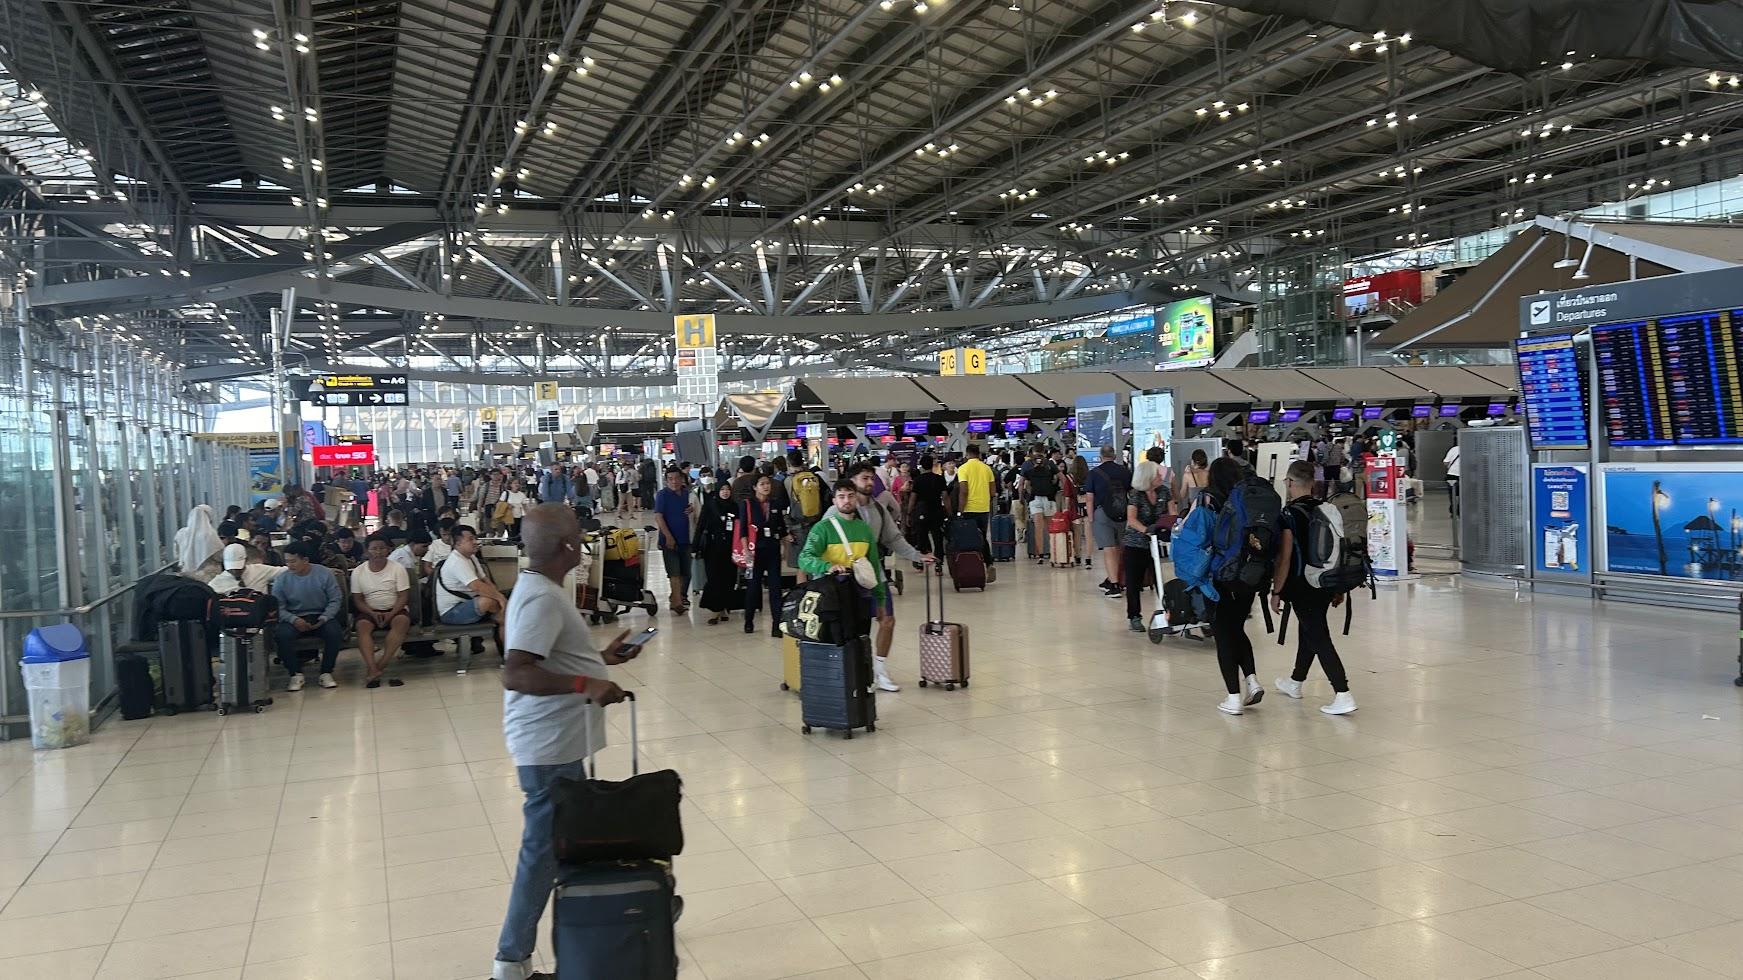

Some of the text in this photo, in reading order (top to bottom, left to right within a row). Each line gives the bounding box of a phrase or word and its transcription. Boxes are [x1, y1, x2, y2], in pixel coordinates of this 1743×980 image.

[1556, 293, 1618, 308] เที่ยวบินขาออก
[1556, 308, 1607, 323] Departures
[684, 319, 705, 345] H
[941, 355, 955, 371] F/G
[971, 354, 979, 368] G
[541, 383, 550, 399] F
[484, 410, 493, 420] D
